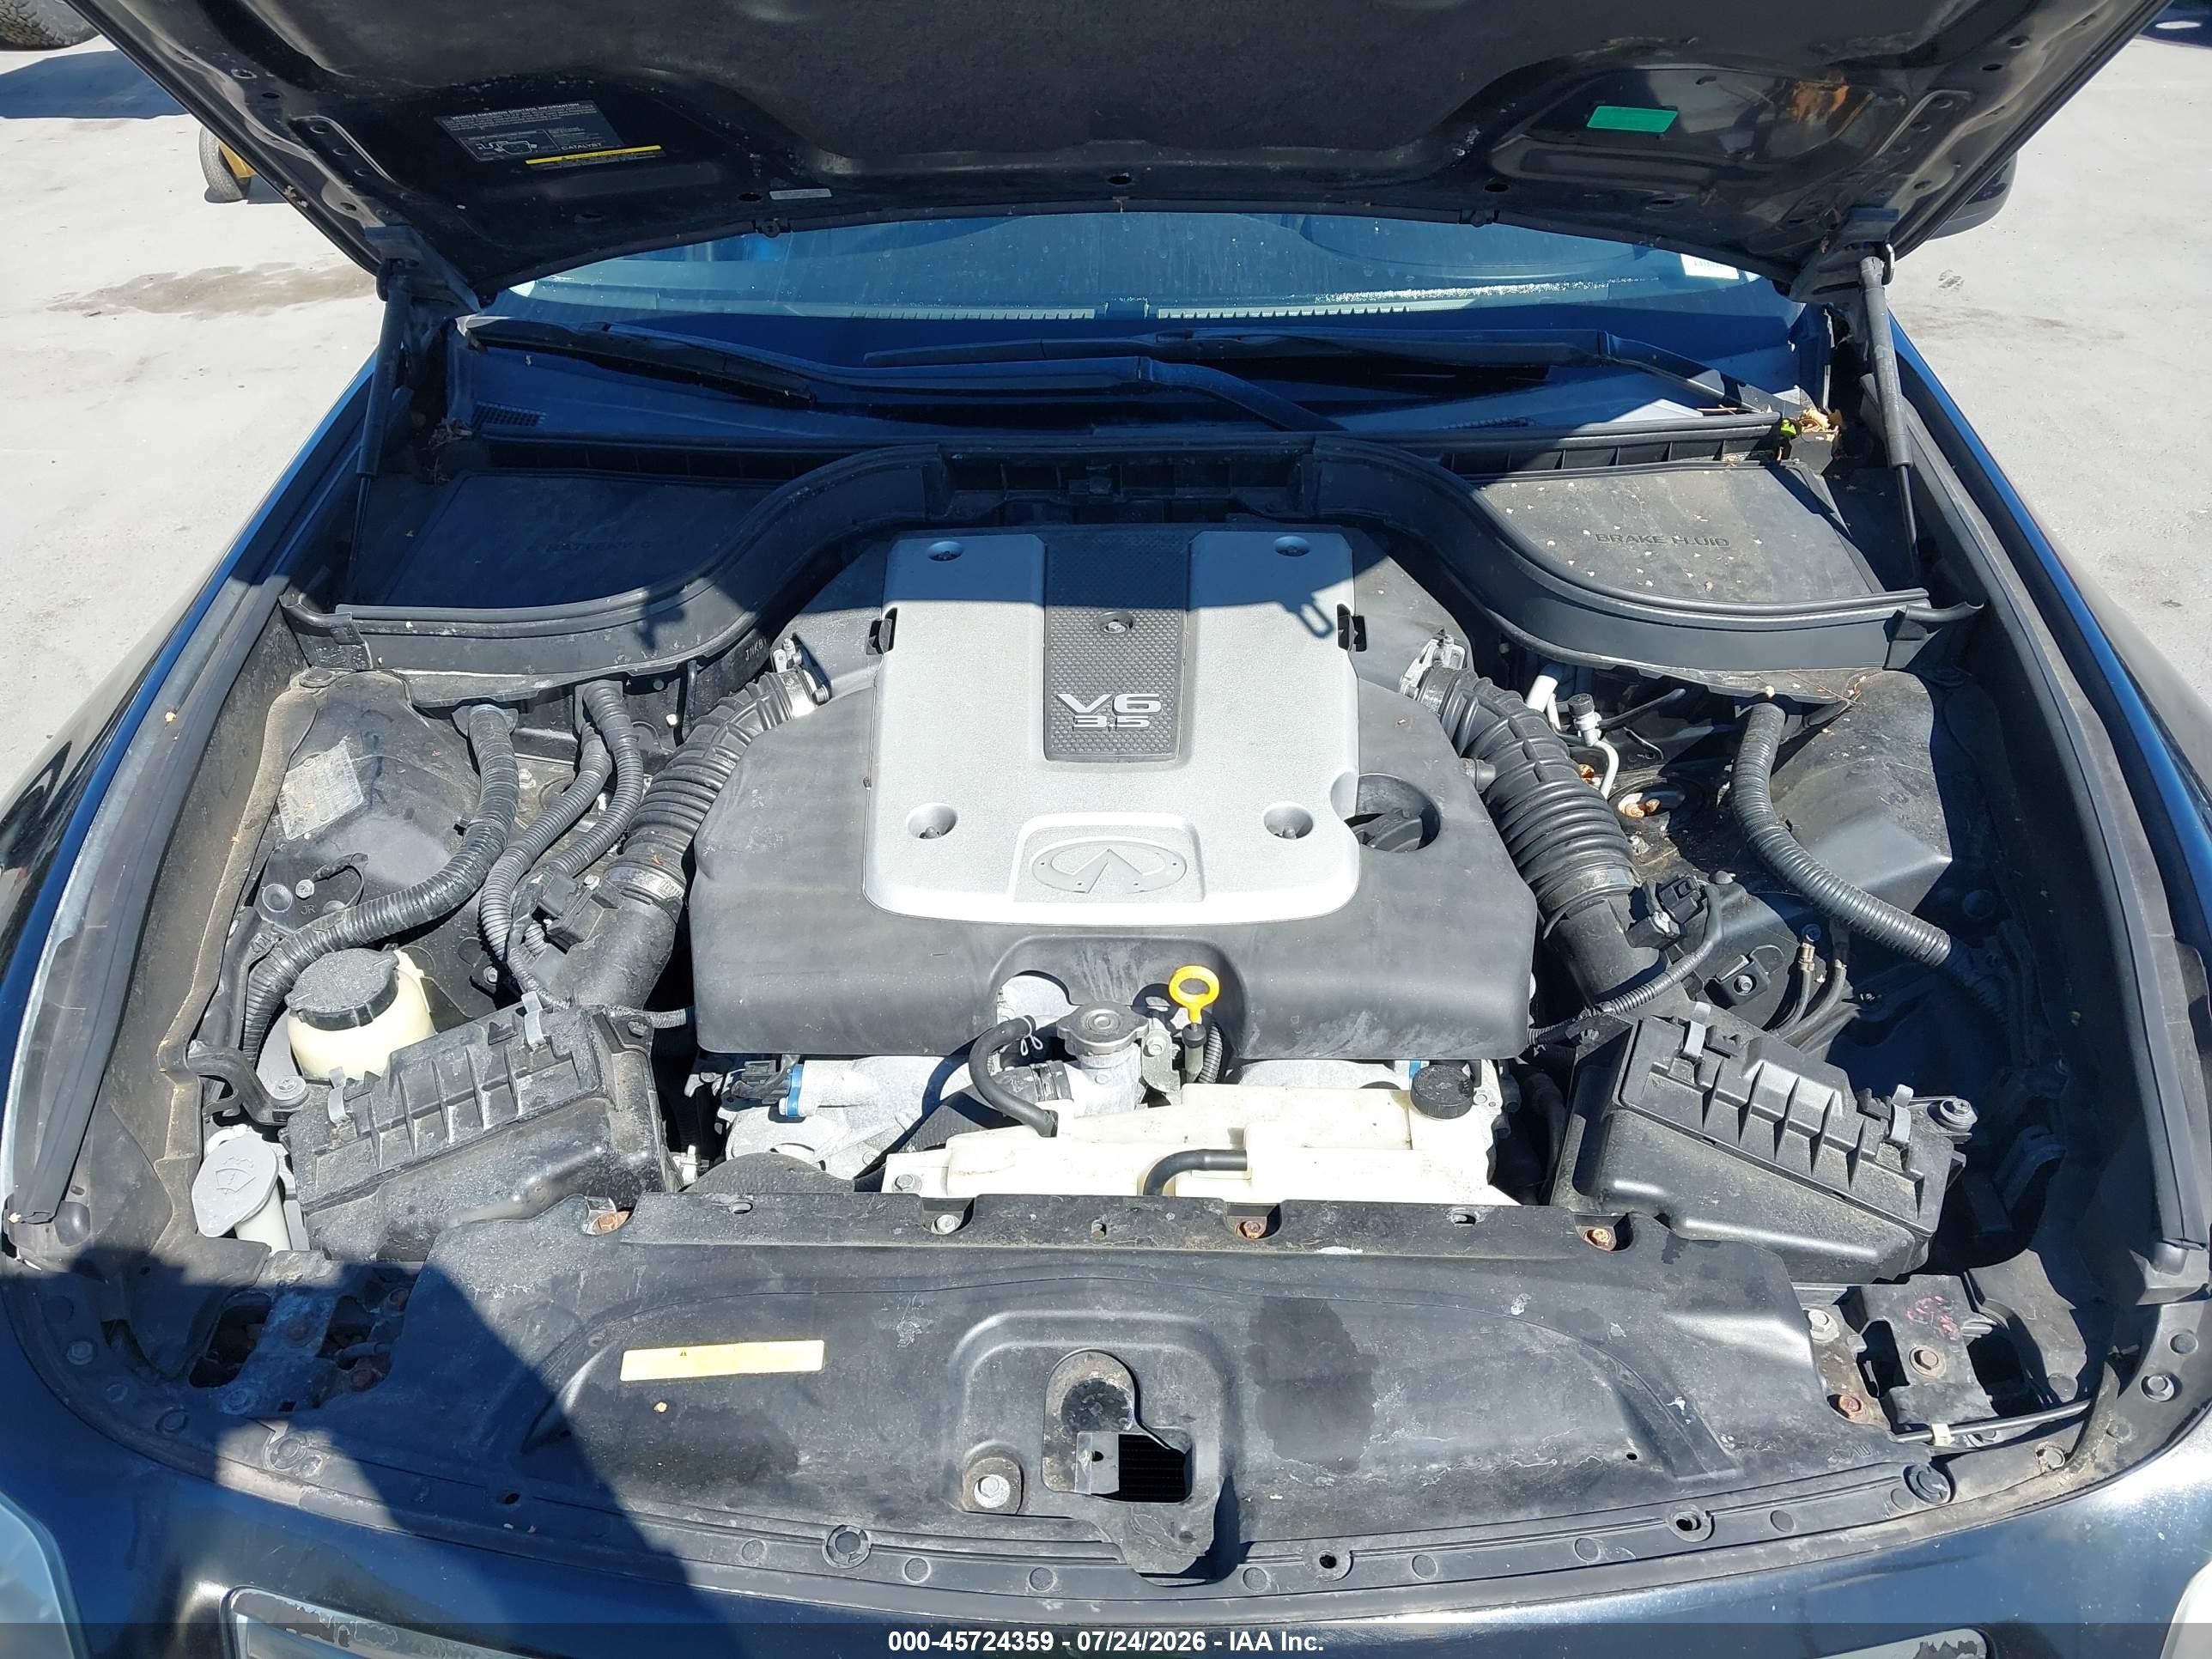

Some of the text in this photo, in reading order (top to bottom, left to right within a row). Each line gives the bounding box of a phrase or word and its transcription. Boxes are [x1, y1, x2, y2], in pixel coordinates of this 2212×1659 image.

[561, 142, 603, 150] CATALYST
[1595, 533, 1732, 548] BRAKE FLUID
[1056, 693, 1162, 715] V6
[1073, 715, 1151, 730] 3.5
[301, 904, 316, 915] JR
